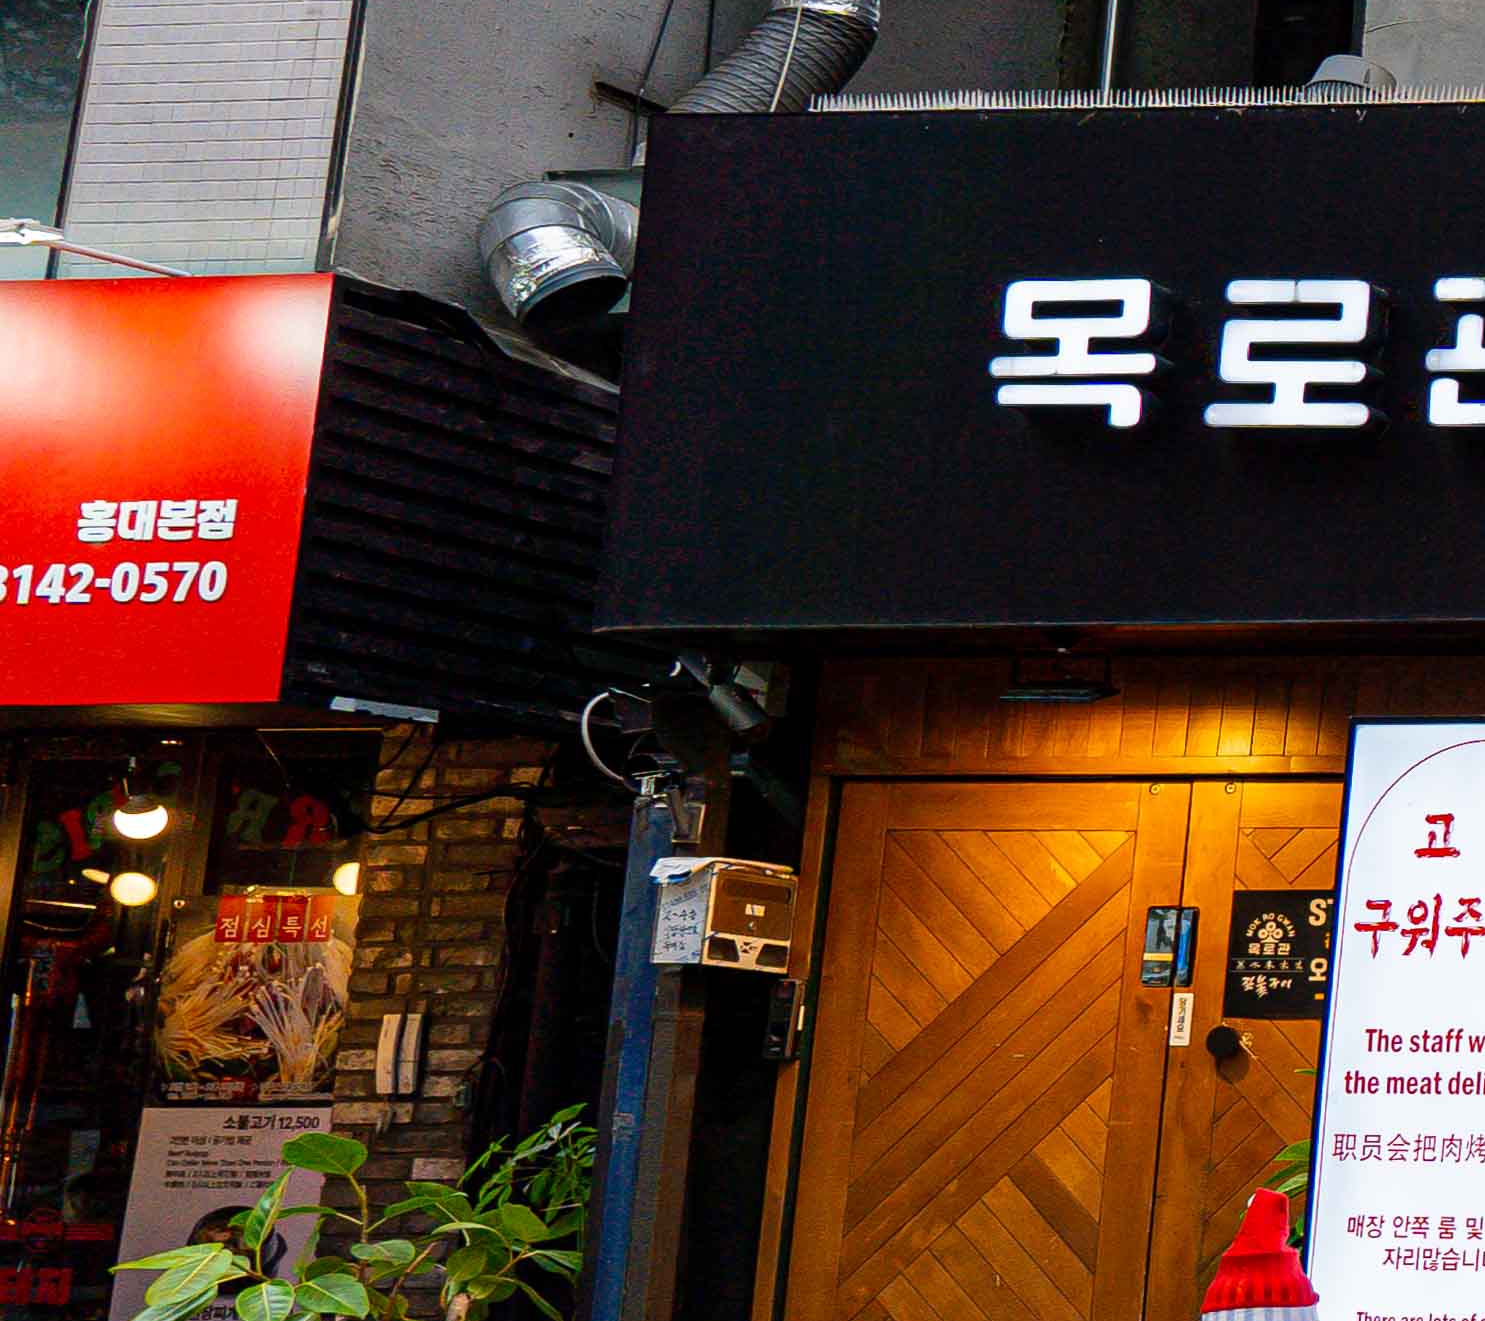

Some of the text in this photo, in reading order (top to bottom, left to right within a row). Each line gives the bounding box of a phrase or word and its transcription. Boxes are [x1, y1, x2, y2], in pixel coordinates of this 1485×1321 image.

[76, 498, 239, 544] 홍대본점
[0, 560, 229, 606] 142-0570
[219, 916, 329, 938] 점심특선
[1364, 1028, 1404, 1053] The
[1409, 1028, 1464, 1054] staff
[1344, 1071, 1382, 1094] the
[1386, 1073, 1443, 1095] meat
[278, 1116, 320, 1130] 12,500
[1346, 1215, 1385, 1239] 매장
[1391, 1215, 1430, 1240] 안쪽
[1437, 1216, 1458, 1241] 룸
[1465, 1216, 1484, 1241] 및
